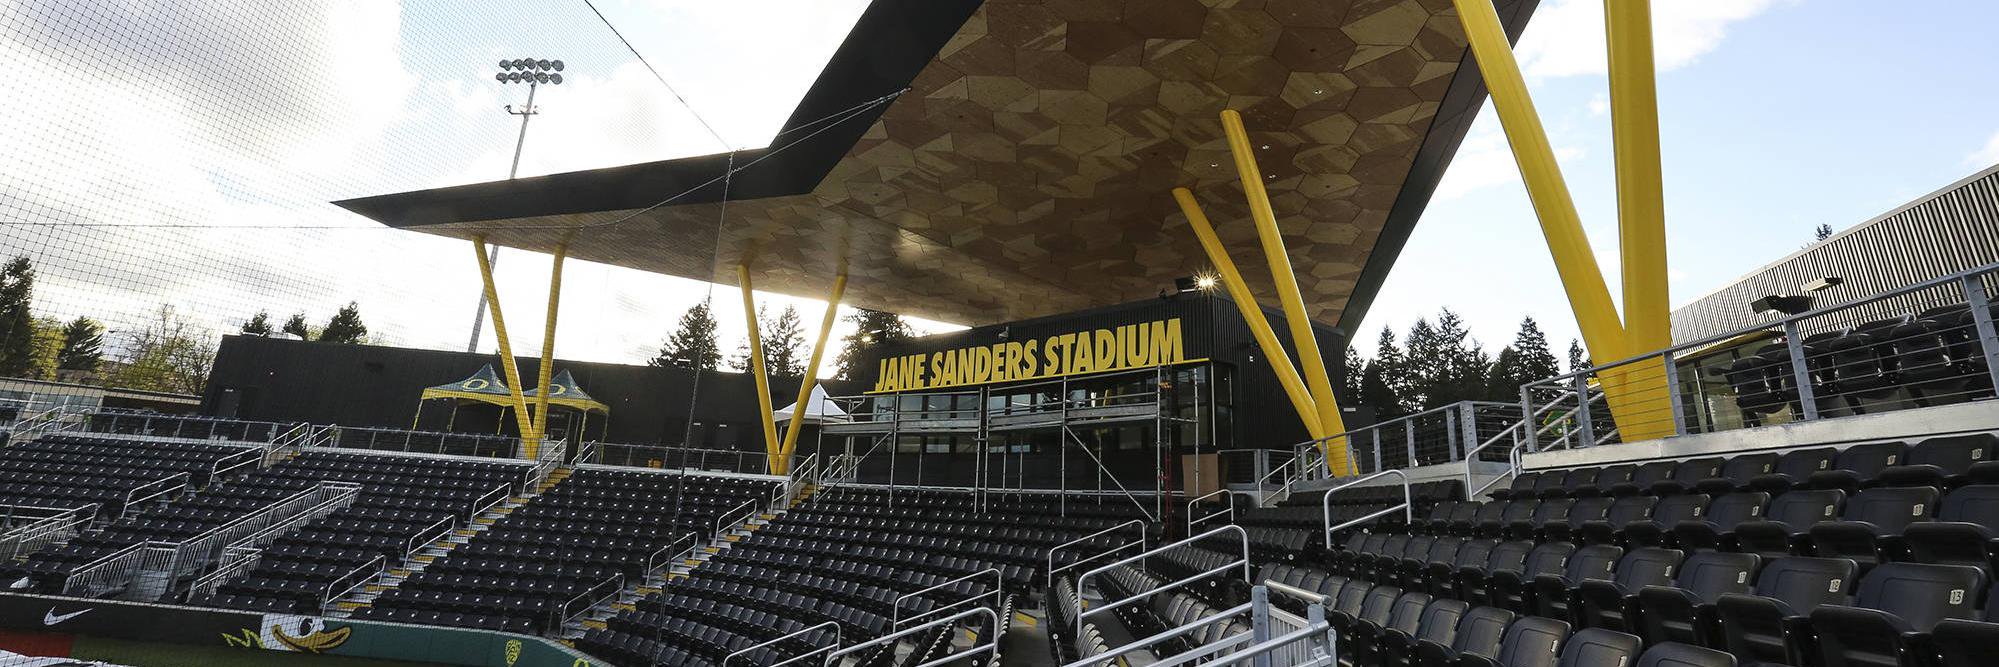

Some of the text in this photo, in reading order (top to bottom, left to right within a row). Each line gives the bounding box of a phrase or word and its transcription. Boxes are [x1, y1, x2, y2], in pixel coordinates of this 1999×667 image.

[875, 318, 1184, 392] JANE SANDERS STADIUM
[1950, 589, 1964, 604] 13
